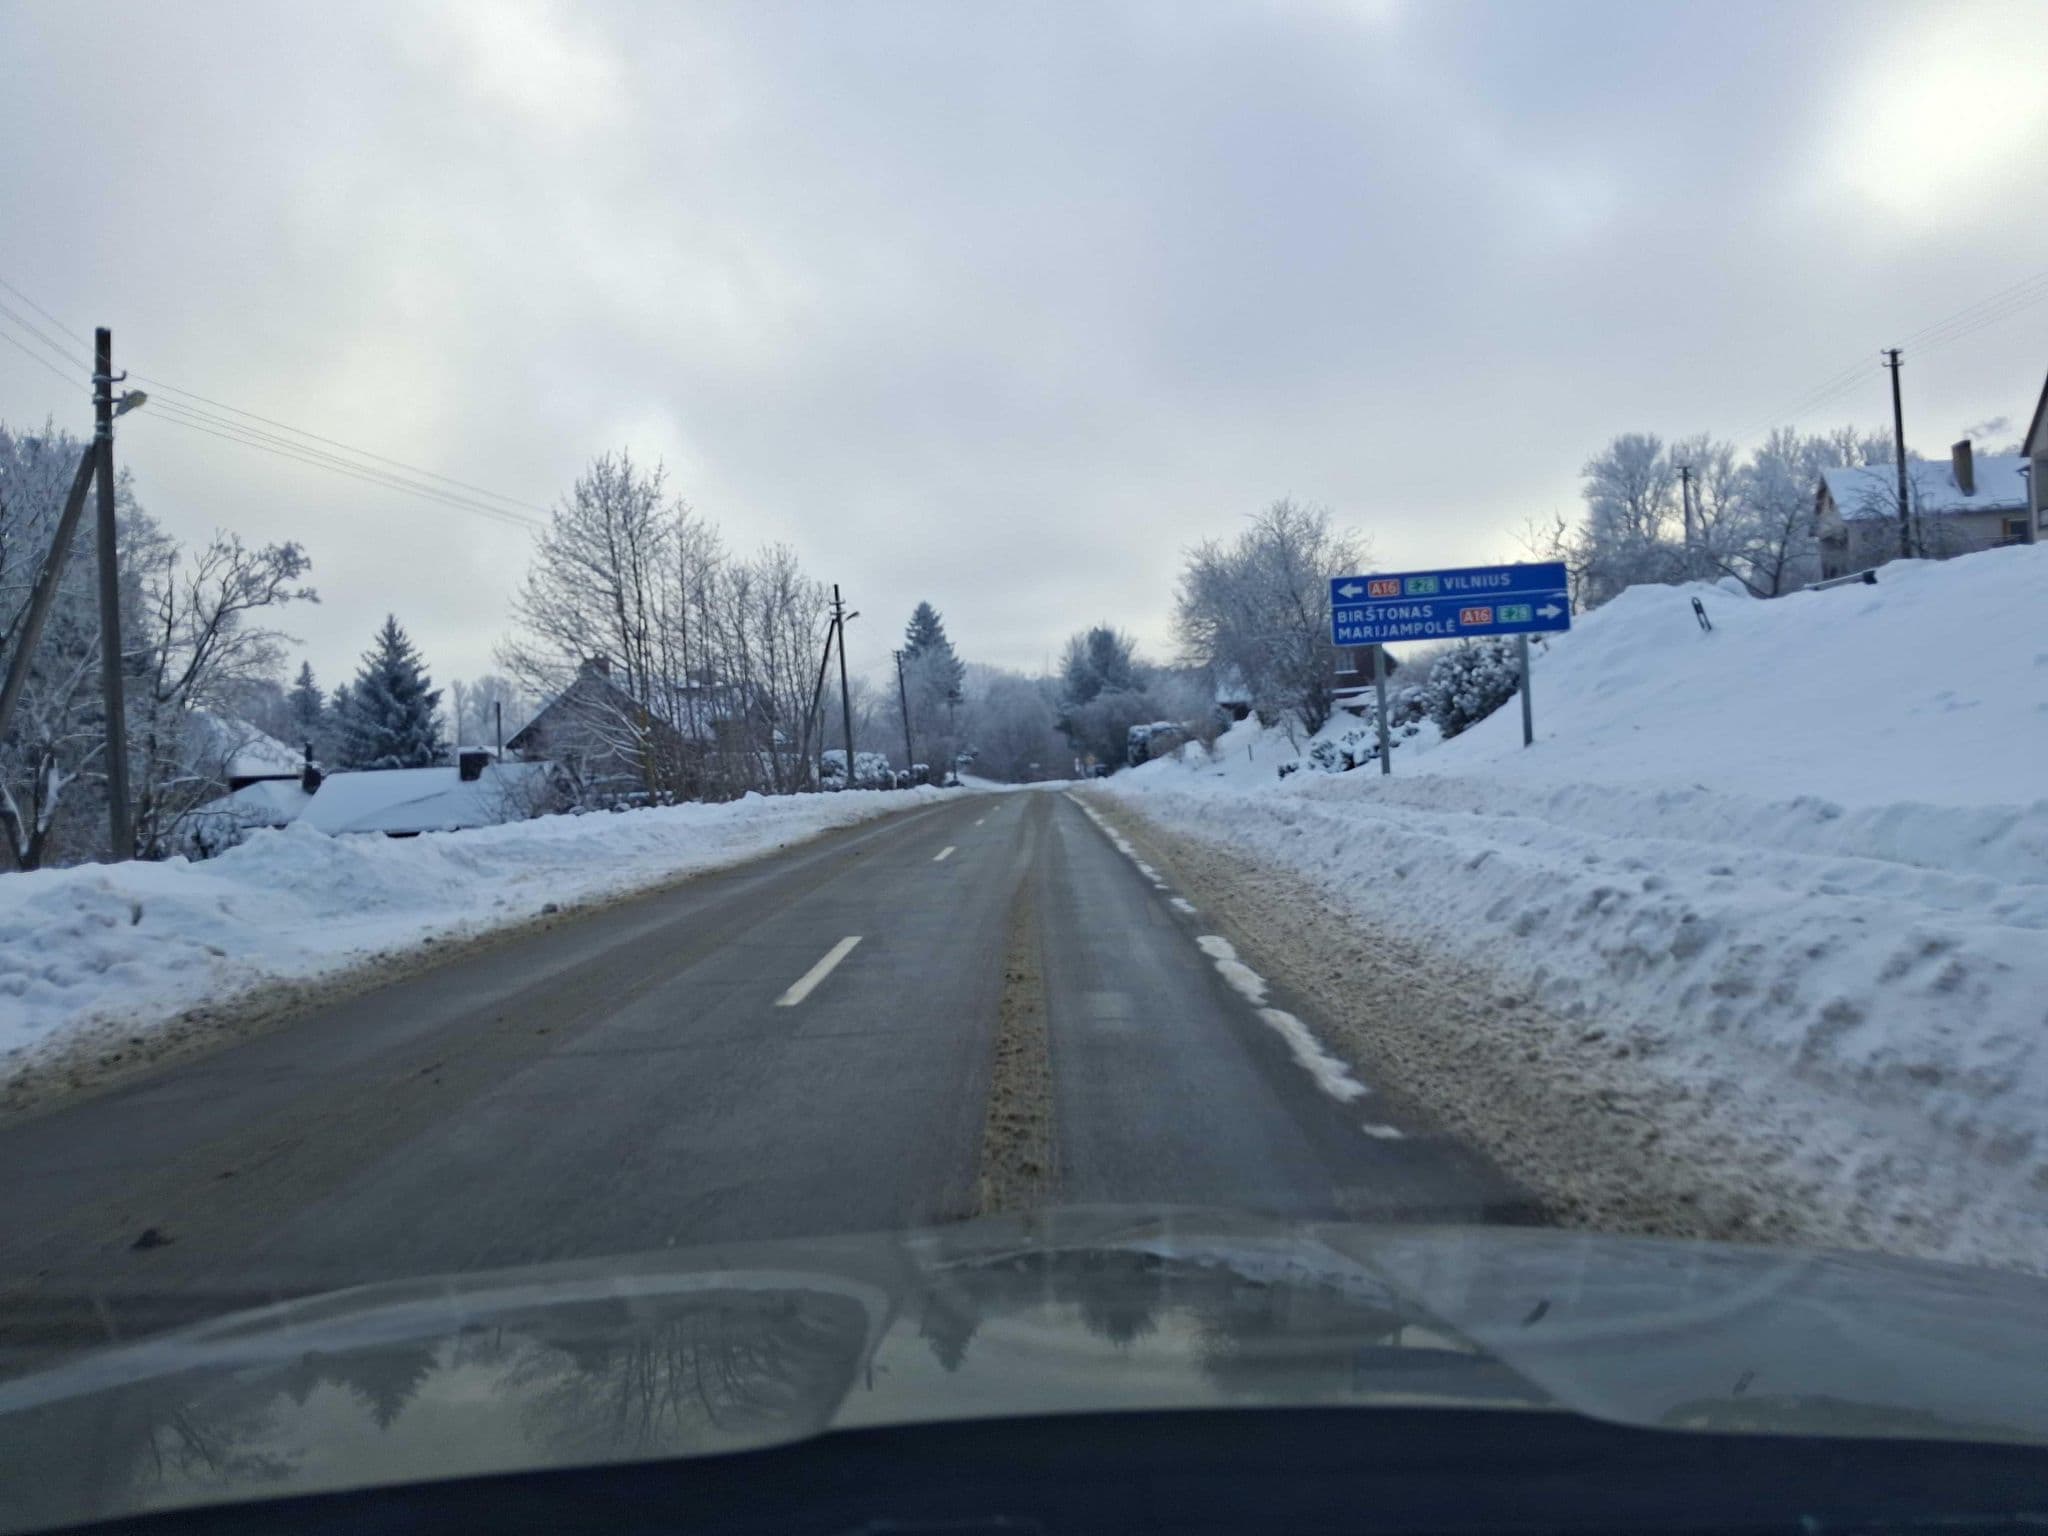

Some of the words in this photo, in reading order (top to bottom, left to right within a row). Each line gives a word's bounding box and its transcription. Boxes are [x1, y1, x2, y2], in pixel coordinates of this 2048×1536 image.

[1371, 581, 1397, 594] A16
[1443, 573, 1511, 589] VILNIUS
[1337, 605, 1433, 623] BIRŠTONAS
[1462, 609, 1489, 623] A16
